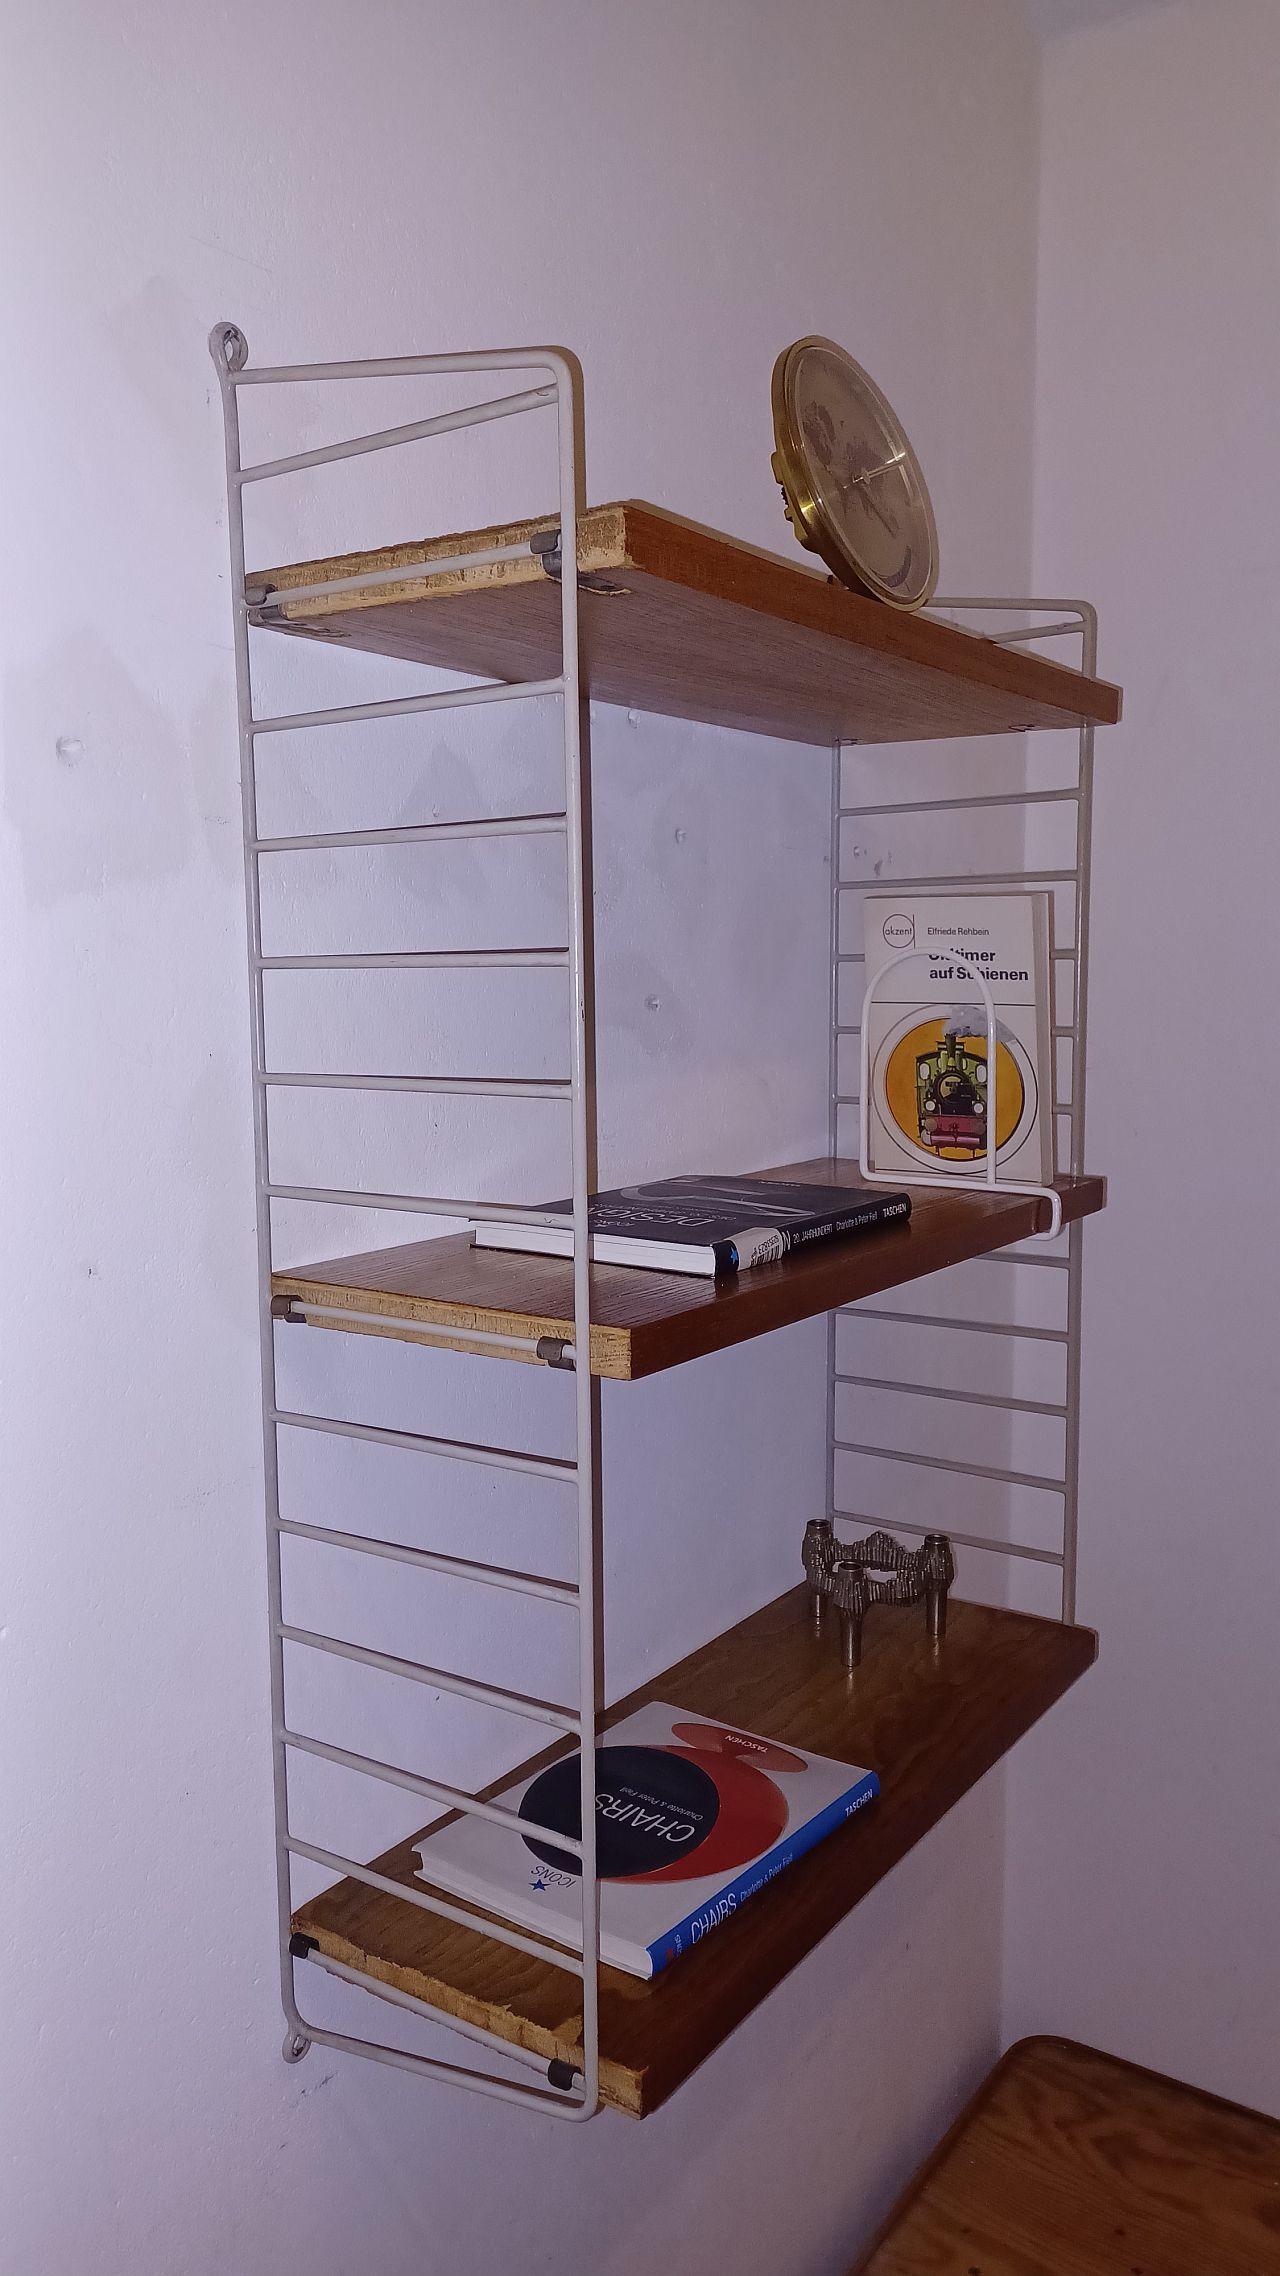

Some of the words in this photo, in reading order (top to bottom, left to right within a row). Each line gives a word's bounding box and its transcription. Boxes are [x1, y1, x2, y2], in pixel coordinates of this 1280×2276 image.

[885, 925, 912, 936] akzent
[927, 927, 957, 936] Elfriede
[957, 927, 990, 936] Rehbein
[928, 948, 996, 961] Oimer
[929, 966, 955, 979] auf
[882, 1202, 907, 1218] TASCHEN
[724, 1734, 769, 1753] TASCHEN
[637, 1793, 661, 1805] Peter
[595, 1793, 695, 1842] CHAIRS
[666, 1804, 704, 1821] Charlotte
[690, 1892, 737, 1944] CHAIRS
[844, 1788, 874, 1817] TASCHEN
[531, 1865, 577, 1888] ICONS
